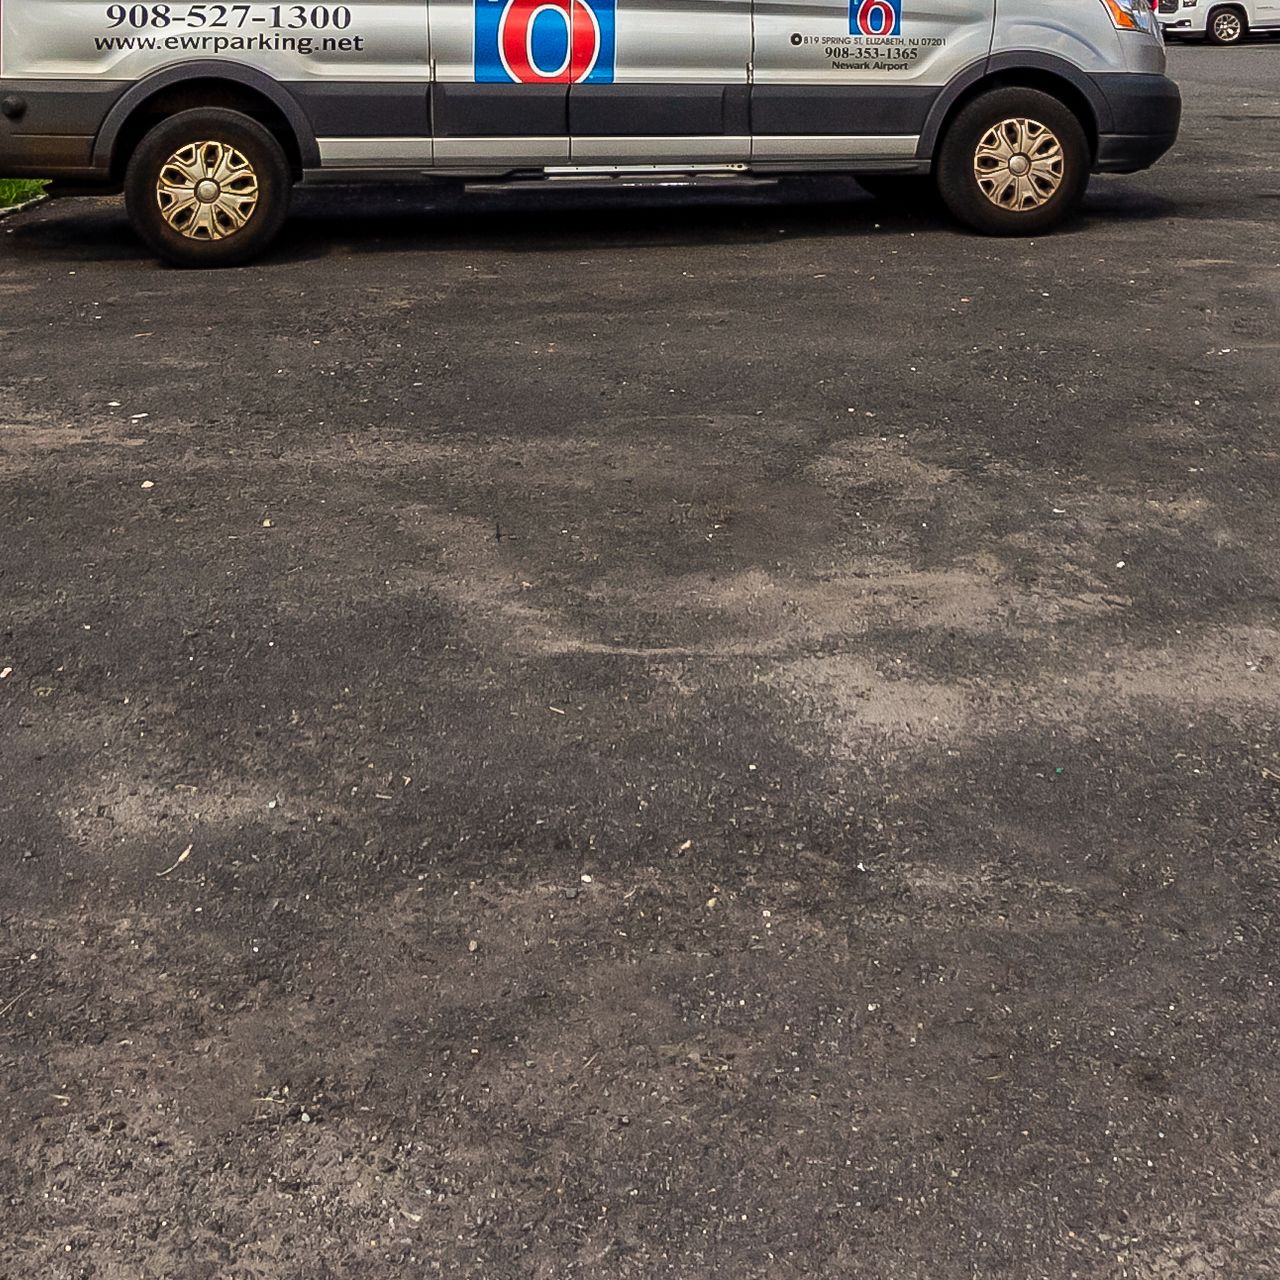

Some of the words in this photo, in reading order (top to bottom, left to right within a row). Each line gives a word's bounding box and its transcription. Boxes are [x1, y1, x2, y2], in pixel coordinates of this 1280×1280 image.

[106, 4, 351, 29] 908-527-1300
[94, 32, 364, 55] www.ewrparking.net
[803, 36, 819, 44] 819
[821, 36, 851, 45] SPRING
[921, 38, 946, 46] 07201
[825, 47, 918, 60] 908-353-1365
[831, 61, 870, 70] Newark
[872, 61, 908, 71] Airport
